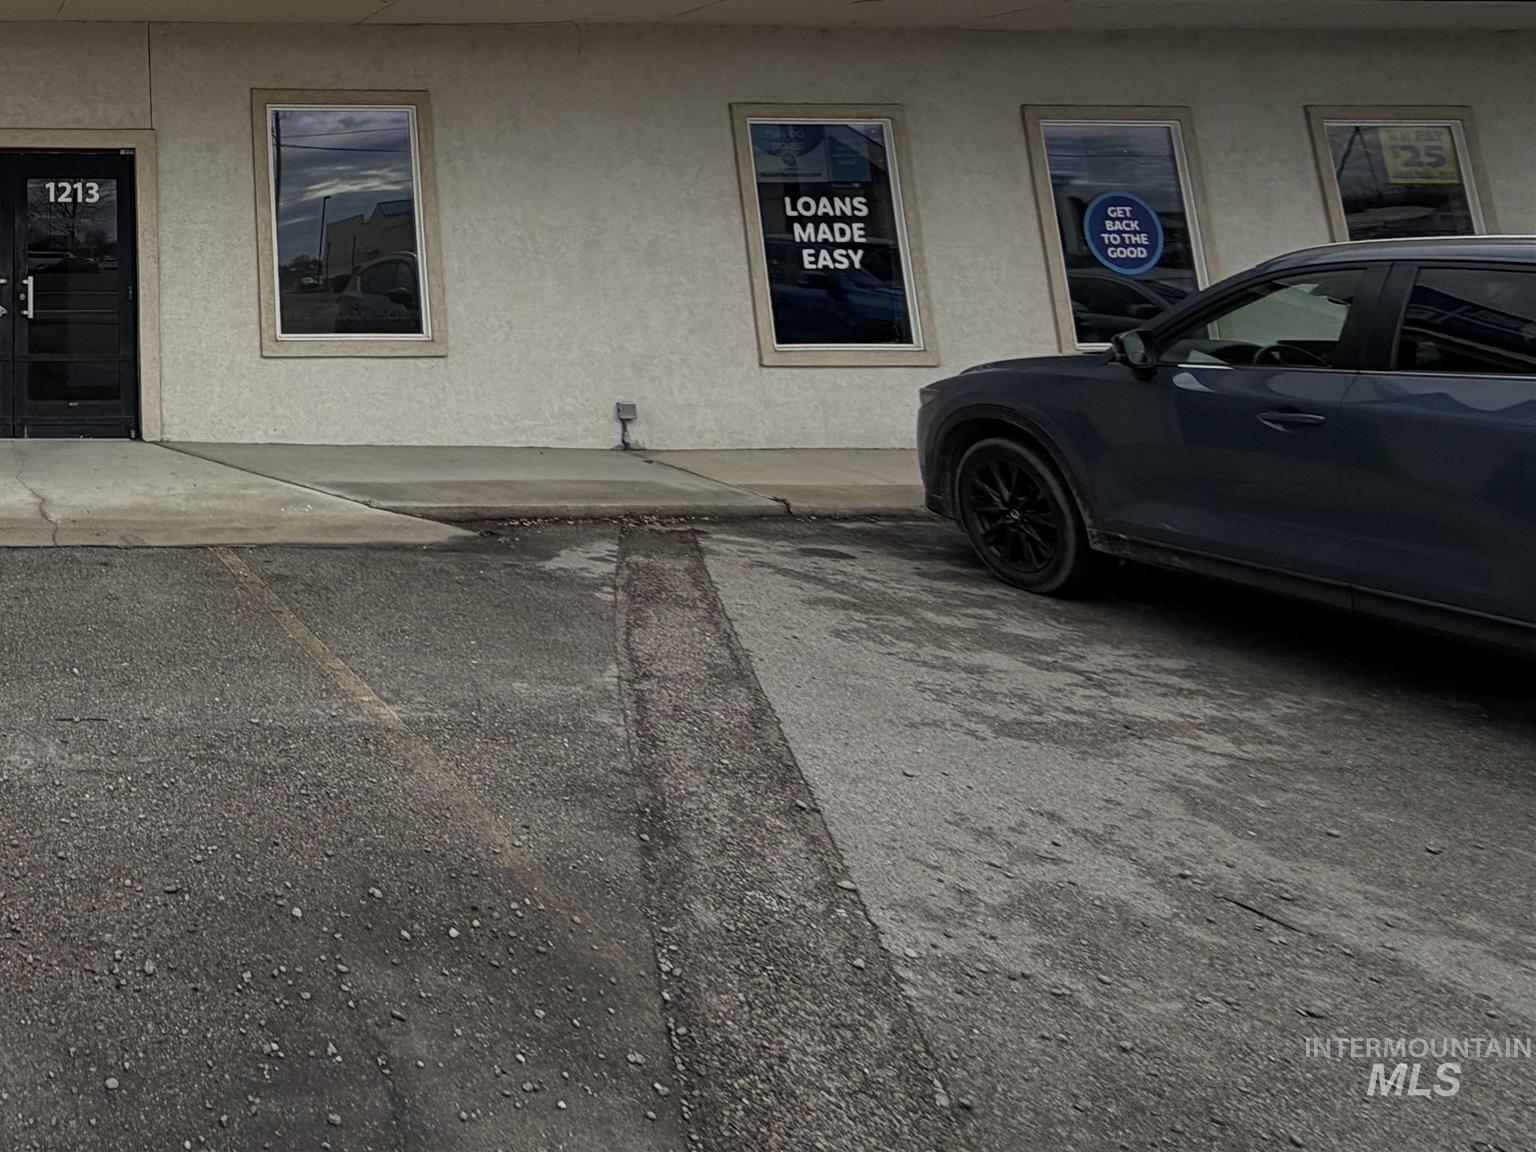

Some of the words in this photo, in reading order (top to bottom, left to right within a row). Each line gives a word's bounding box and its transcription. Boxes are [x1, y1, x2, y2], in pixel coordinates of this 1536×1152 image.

[45, 182, 100, 204] 1213
[784, 196, 869, 217] LOANS
[1107, 206, 1133, 218] GET
[793, 222, 867, 243] MADE
[1105, 220, 1140, 231] BACK
[1100, 233, 1121, 245] TO
[1121, 233, 1150, 245] THE
[802, 248, 864, 270] EASY
[1107, 247, 1148, 258] GOOD
